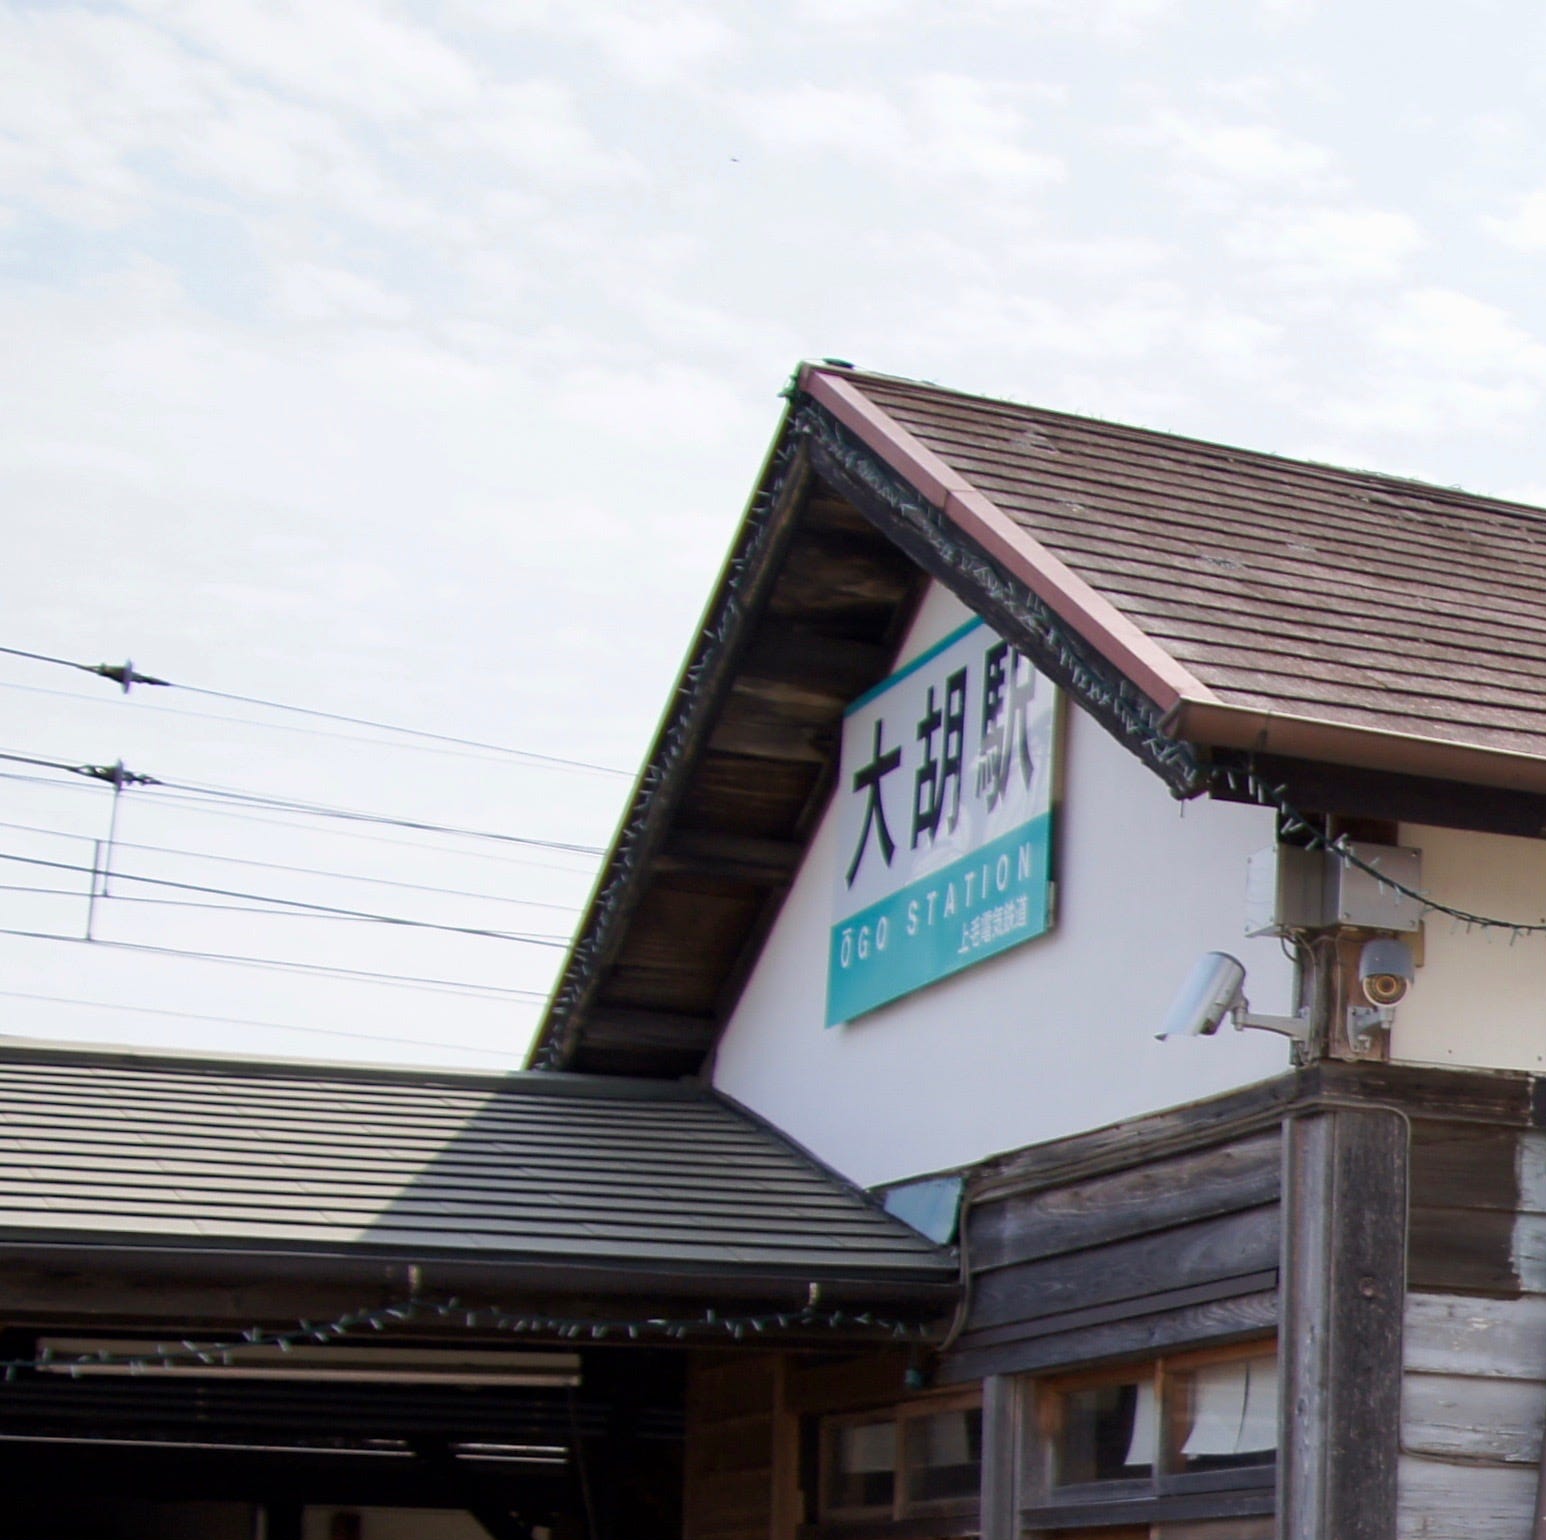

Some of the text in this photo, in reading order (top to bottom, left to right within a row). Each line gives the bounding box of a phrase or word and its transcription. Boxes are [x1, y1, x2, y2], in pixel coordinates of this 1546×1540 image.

[845, 639, 1036, 891] 大胡駅
[906, 841, 1032, 937] STATION
[957, 893, 1029, 955] 上毛電気鉄道
